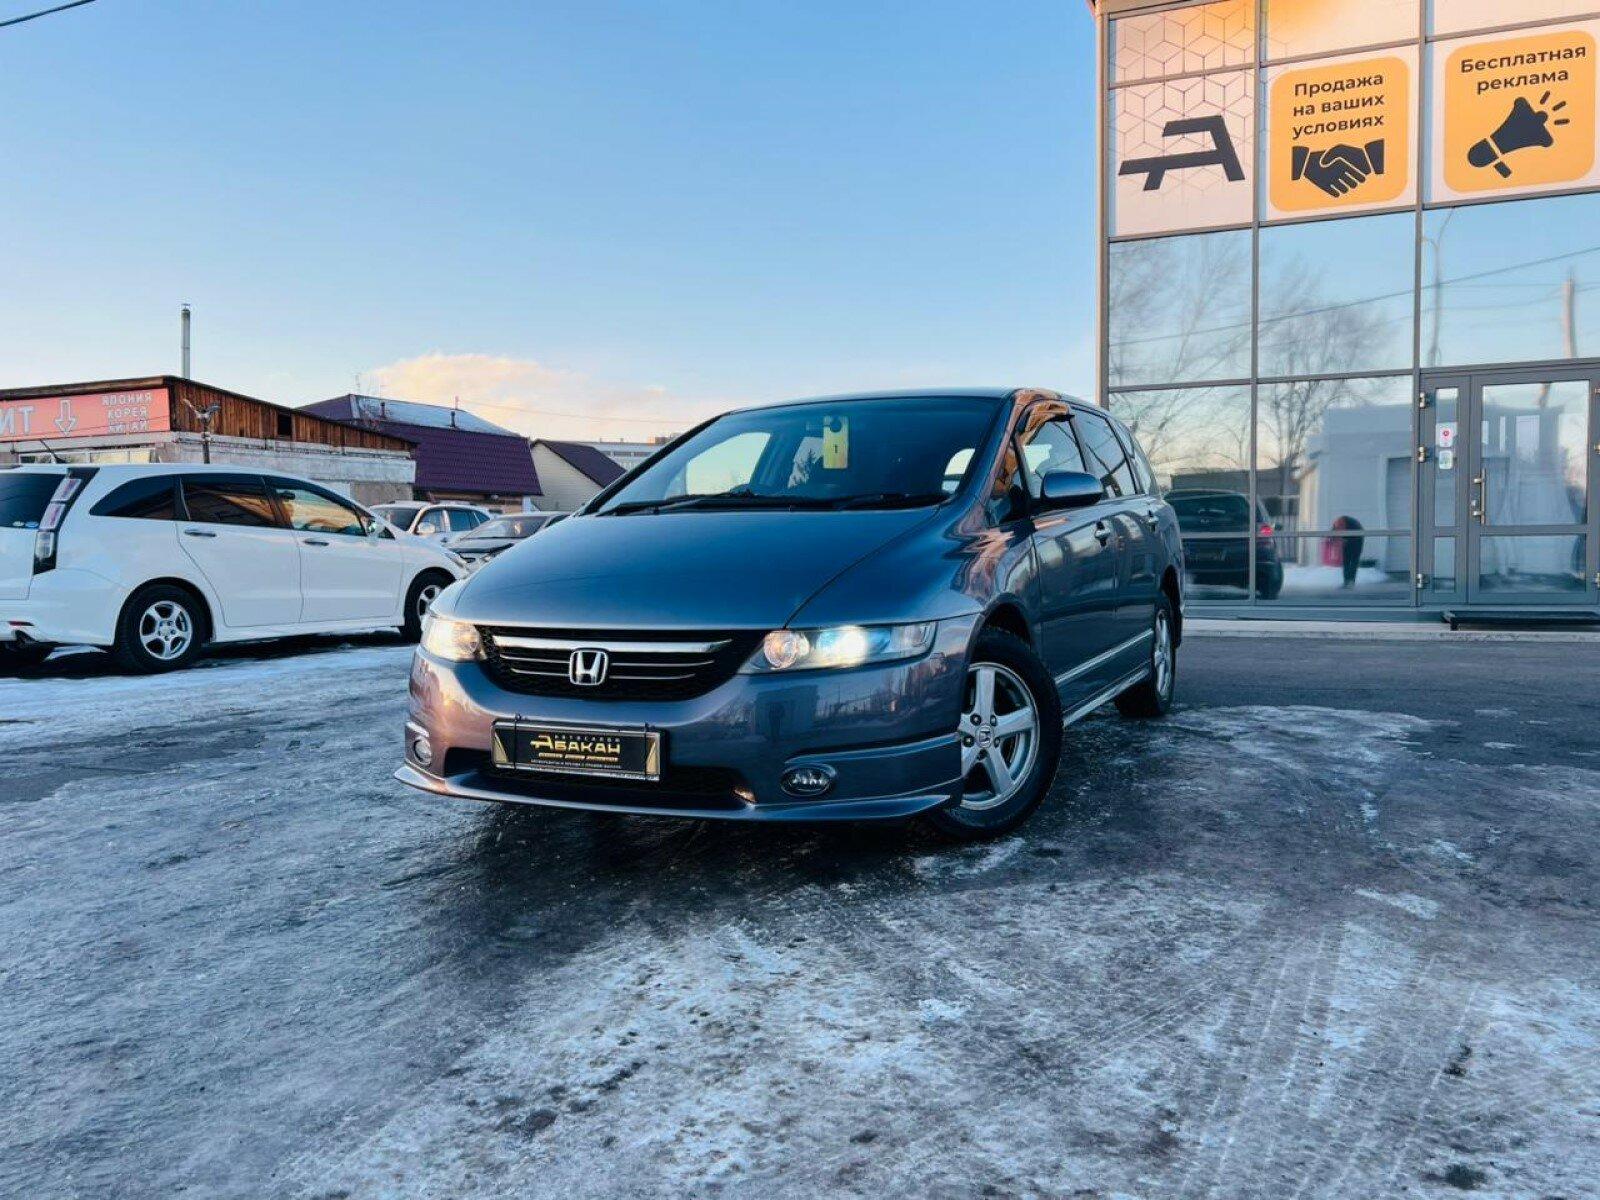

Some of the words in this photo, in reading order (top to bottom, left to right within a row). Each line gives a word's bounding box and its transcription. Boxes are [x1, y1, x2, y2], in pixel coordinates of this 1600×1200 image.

[1460, 46, 1586, 73] Бесплатная
[1294, 74, 1384, 98] Продажа
[1477, 69, 1568, 95] реклама
[1293, 104, 1315, 117] на
[1321, 94, 1385, 113] ваших
[1292, 115, 1384, 140] условиях
[108, 406, 148, 420] КОРЕЯ
[530, 735, 620, 755] АБАКАН
